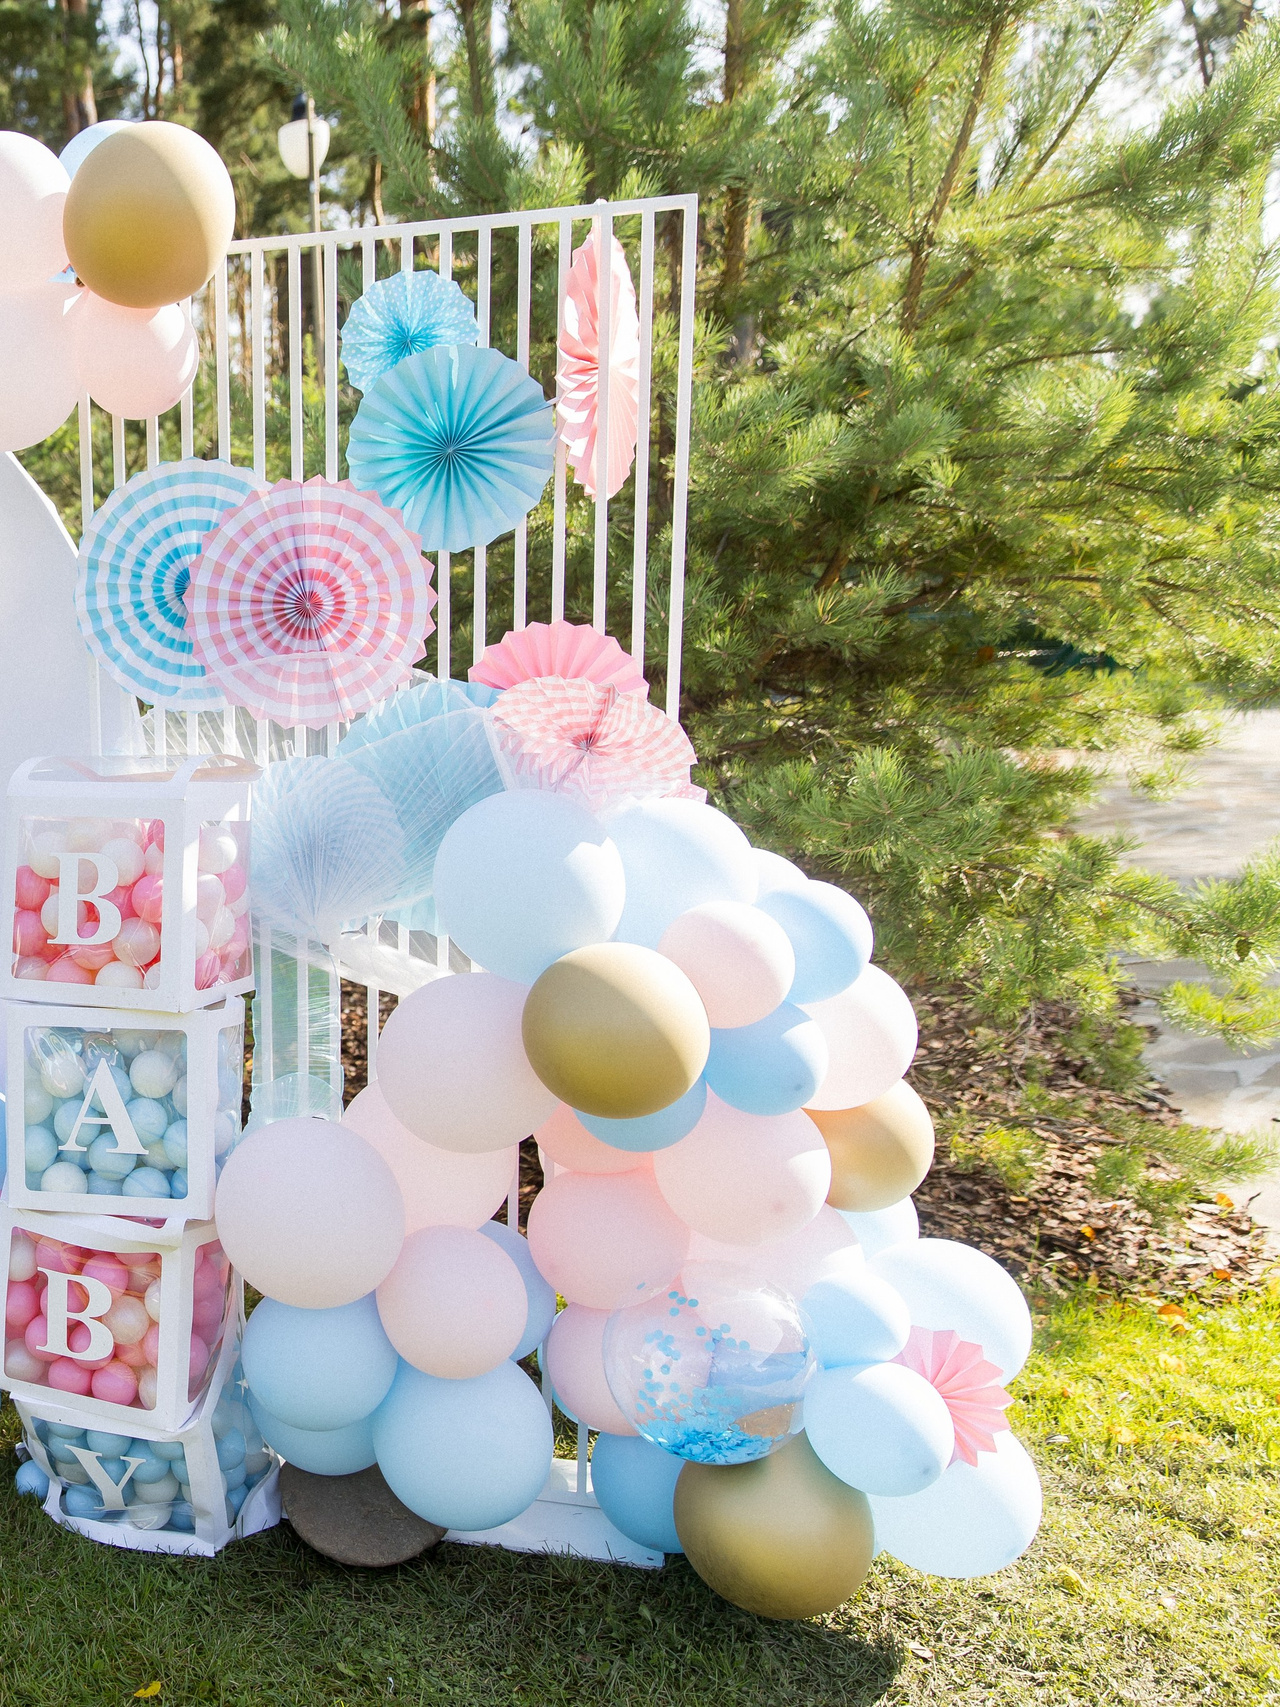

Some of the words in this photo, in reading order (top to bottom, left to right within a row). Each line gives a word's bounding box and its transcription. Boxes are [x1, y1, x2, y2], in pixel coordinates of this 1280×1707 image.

[46, 852, 122, 945] B
[58, 1057, 149, 1155] A
[35, 1266, 115, 1362] B
[64, 1443, 147, 1511] Y
